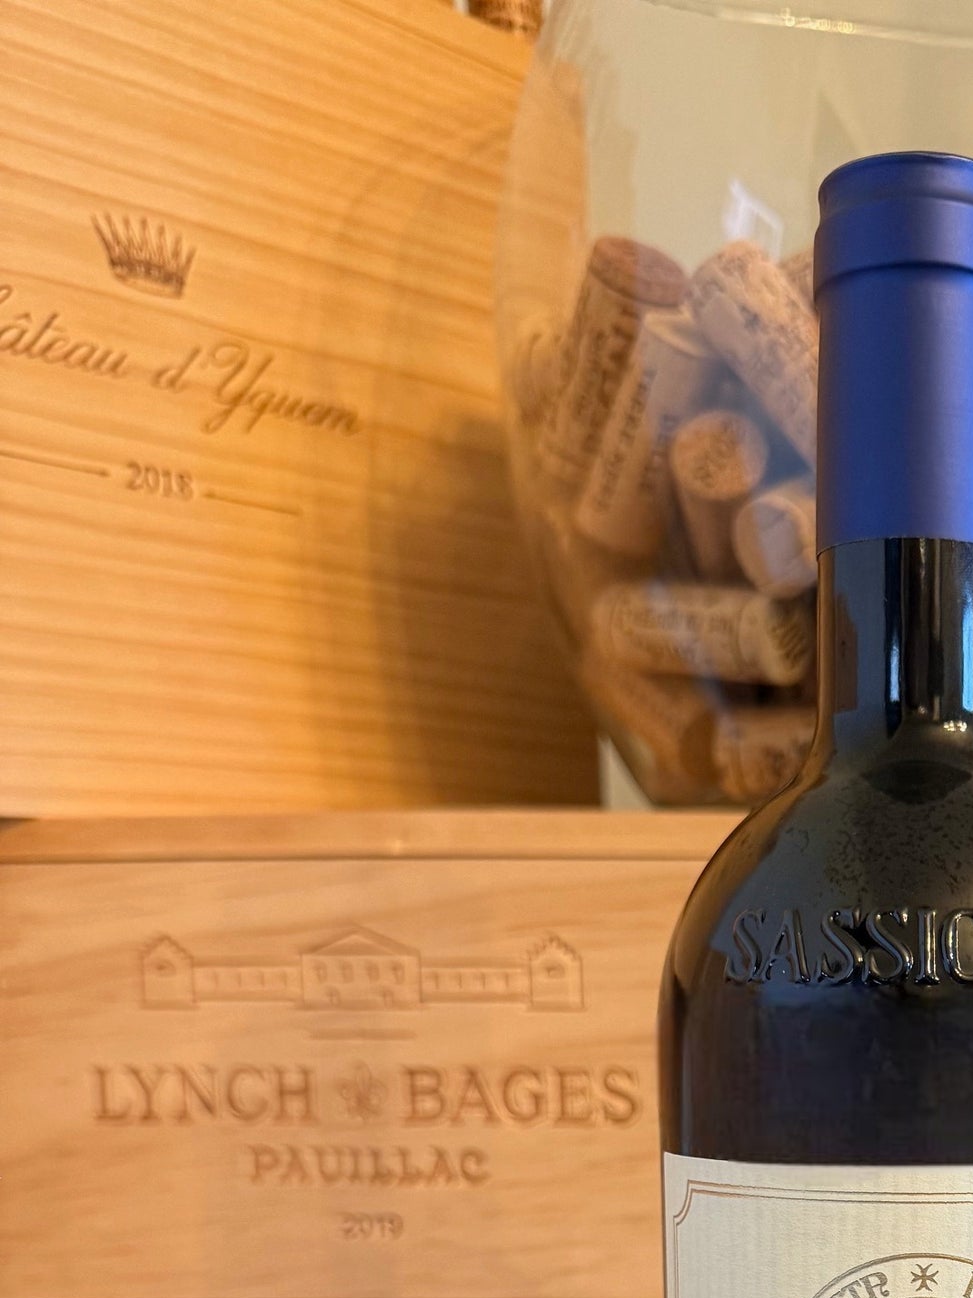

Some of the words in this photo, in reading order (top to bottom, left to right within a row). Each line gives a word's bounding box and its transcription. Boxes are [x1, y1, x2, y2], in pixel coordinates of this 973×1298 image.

[0, 284, 128, 379] âteau
[125, 461, 195, 500] 2018
[91, 1062, 320, 1128] LYNCH
[402, 1062, 642, 1128] BAGES
[247, 1143, 492, 1188] PAUILLAC
